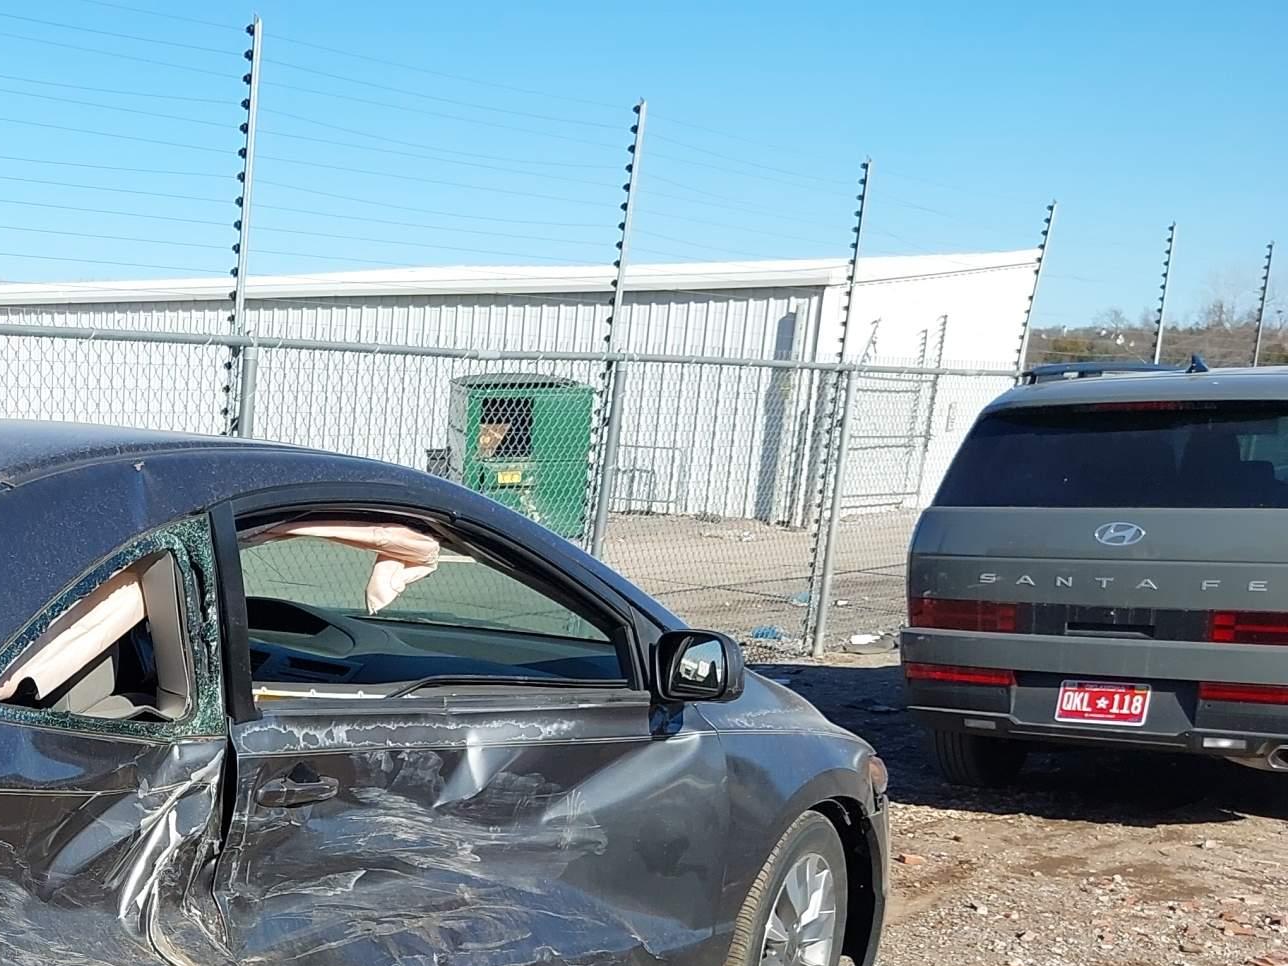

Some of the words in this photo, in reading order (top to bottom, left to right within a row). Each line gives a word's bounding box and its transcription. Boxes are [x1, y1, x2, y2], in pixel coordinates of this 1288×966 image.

[979, 573, 1158, 590] SANTA
[1201, 580, 1268, 592] FE
[1062, 691, 1092, 712] QKL
[1109, 693, 1143, 715] 118
